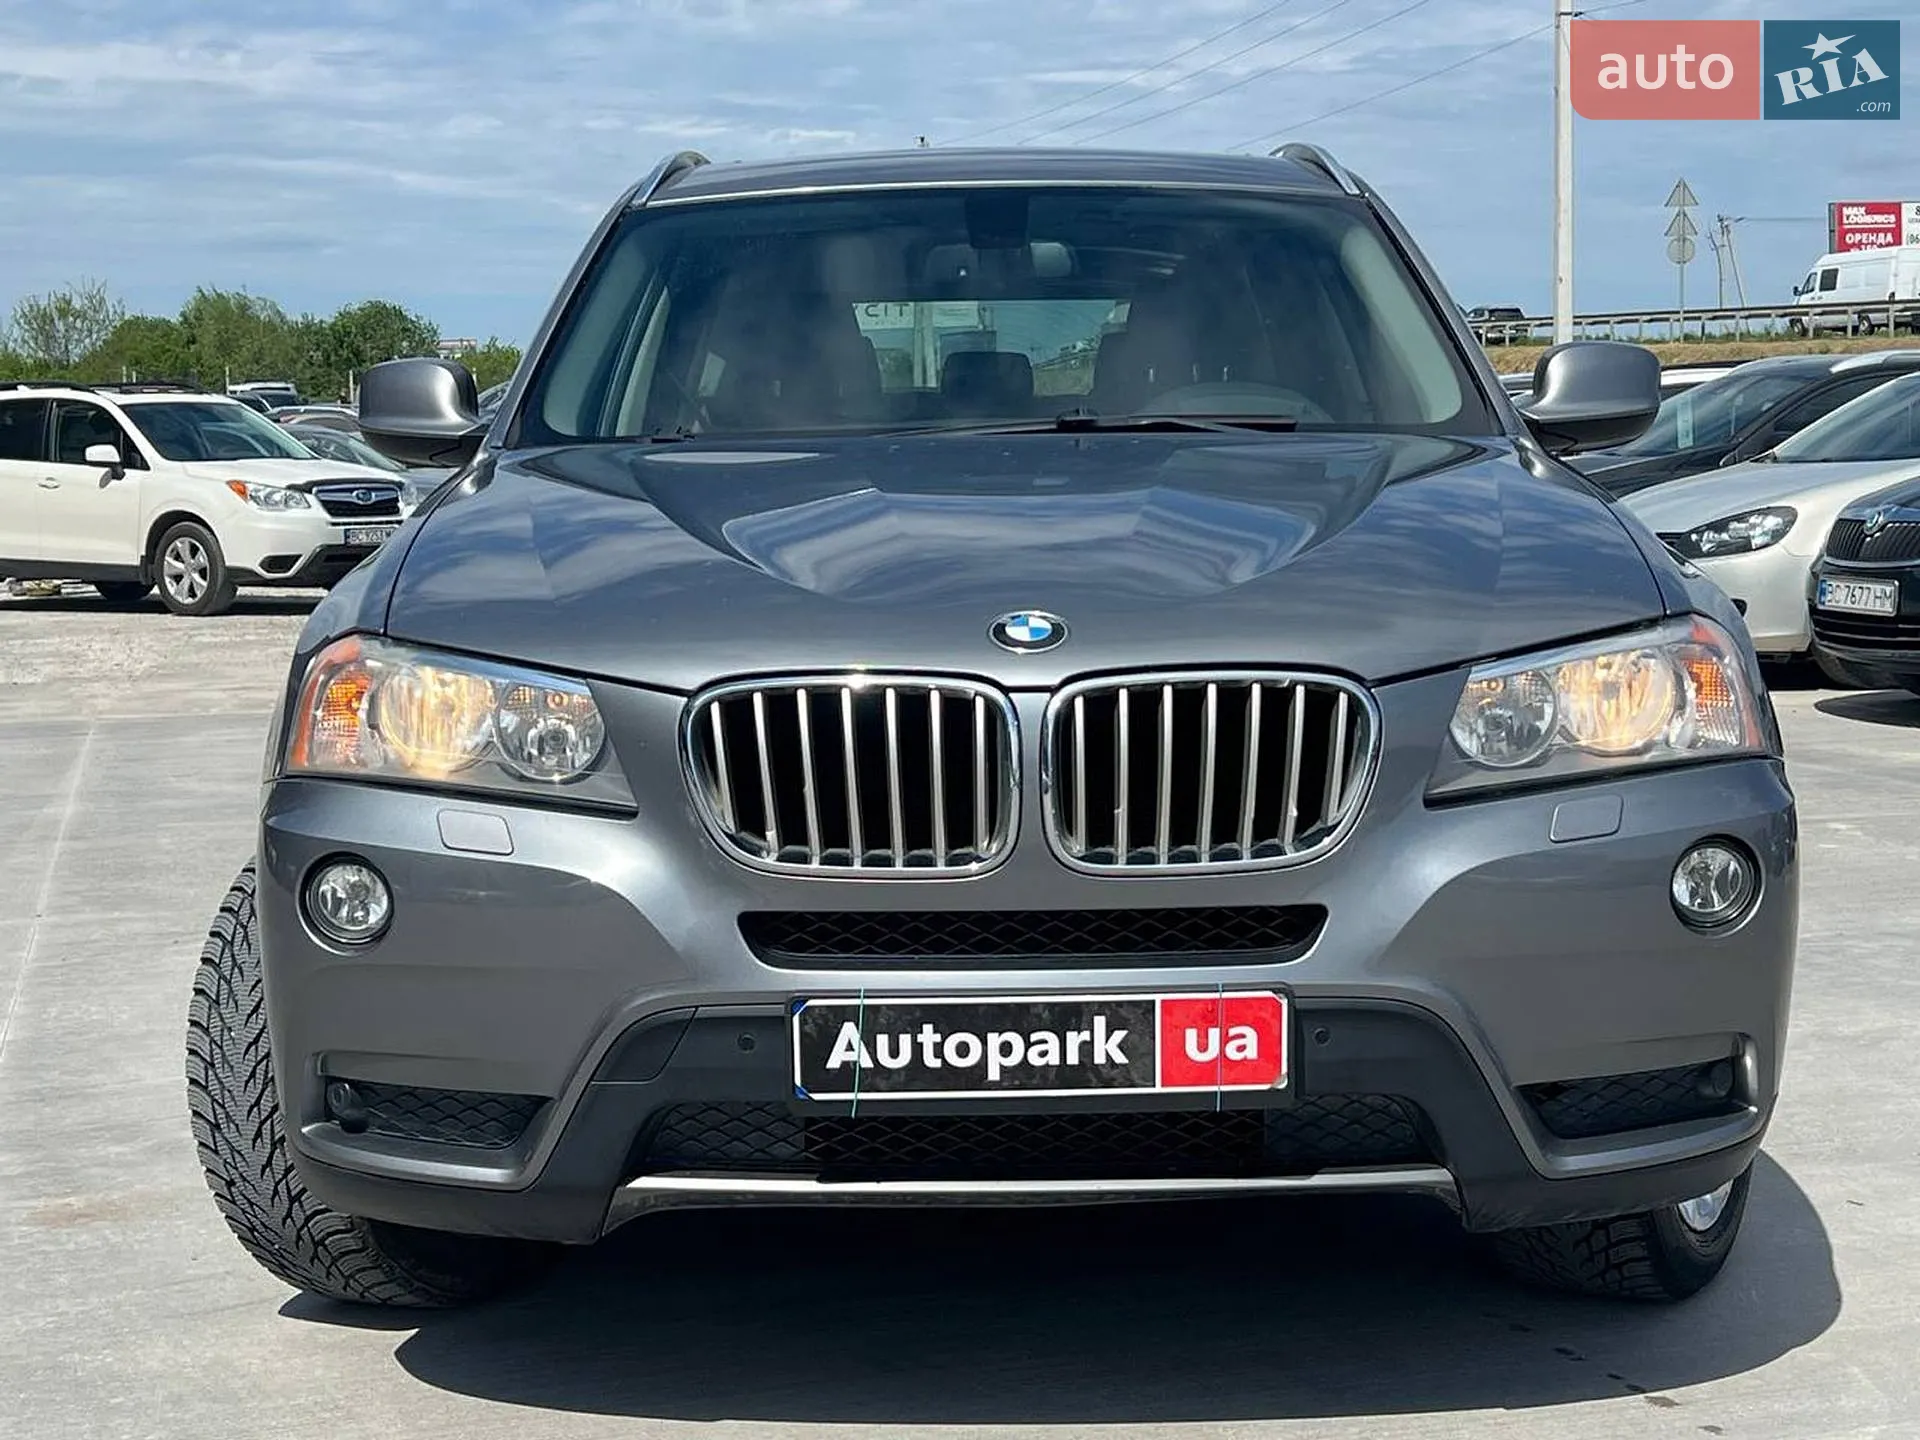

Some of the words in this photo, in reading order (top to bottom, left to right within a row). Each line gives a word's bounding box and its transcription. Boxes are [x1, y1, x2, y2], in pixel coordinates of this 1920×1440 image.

[1845, 232, 1894, 245] ОРЕНДА
[826, 1016, 1131, 1081] Autopark
[1184, 1025, 1259, 1062] ua
